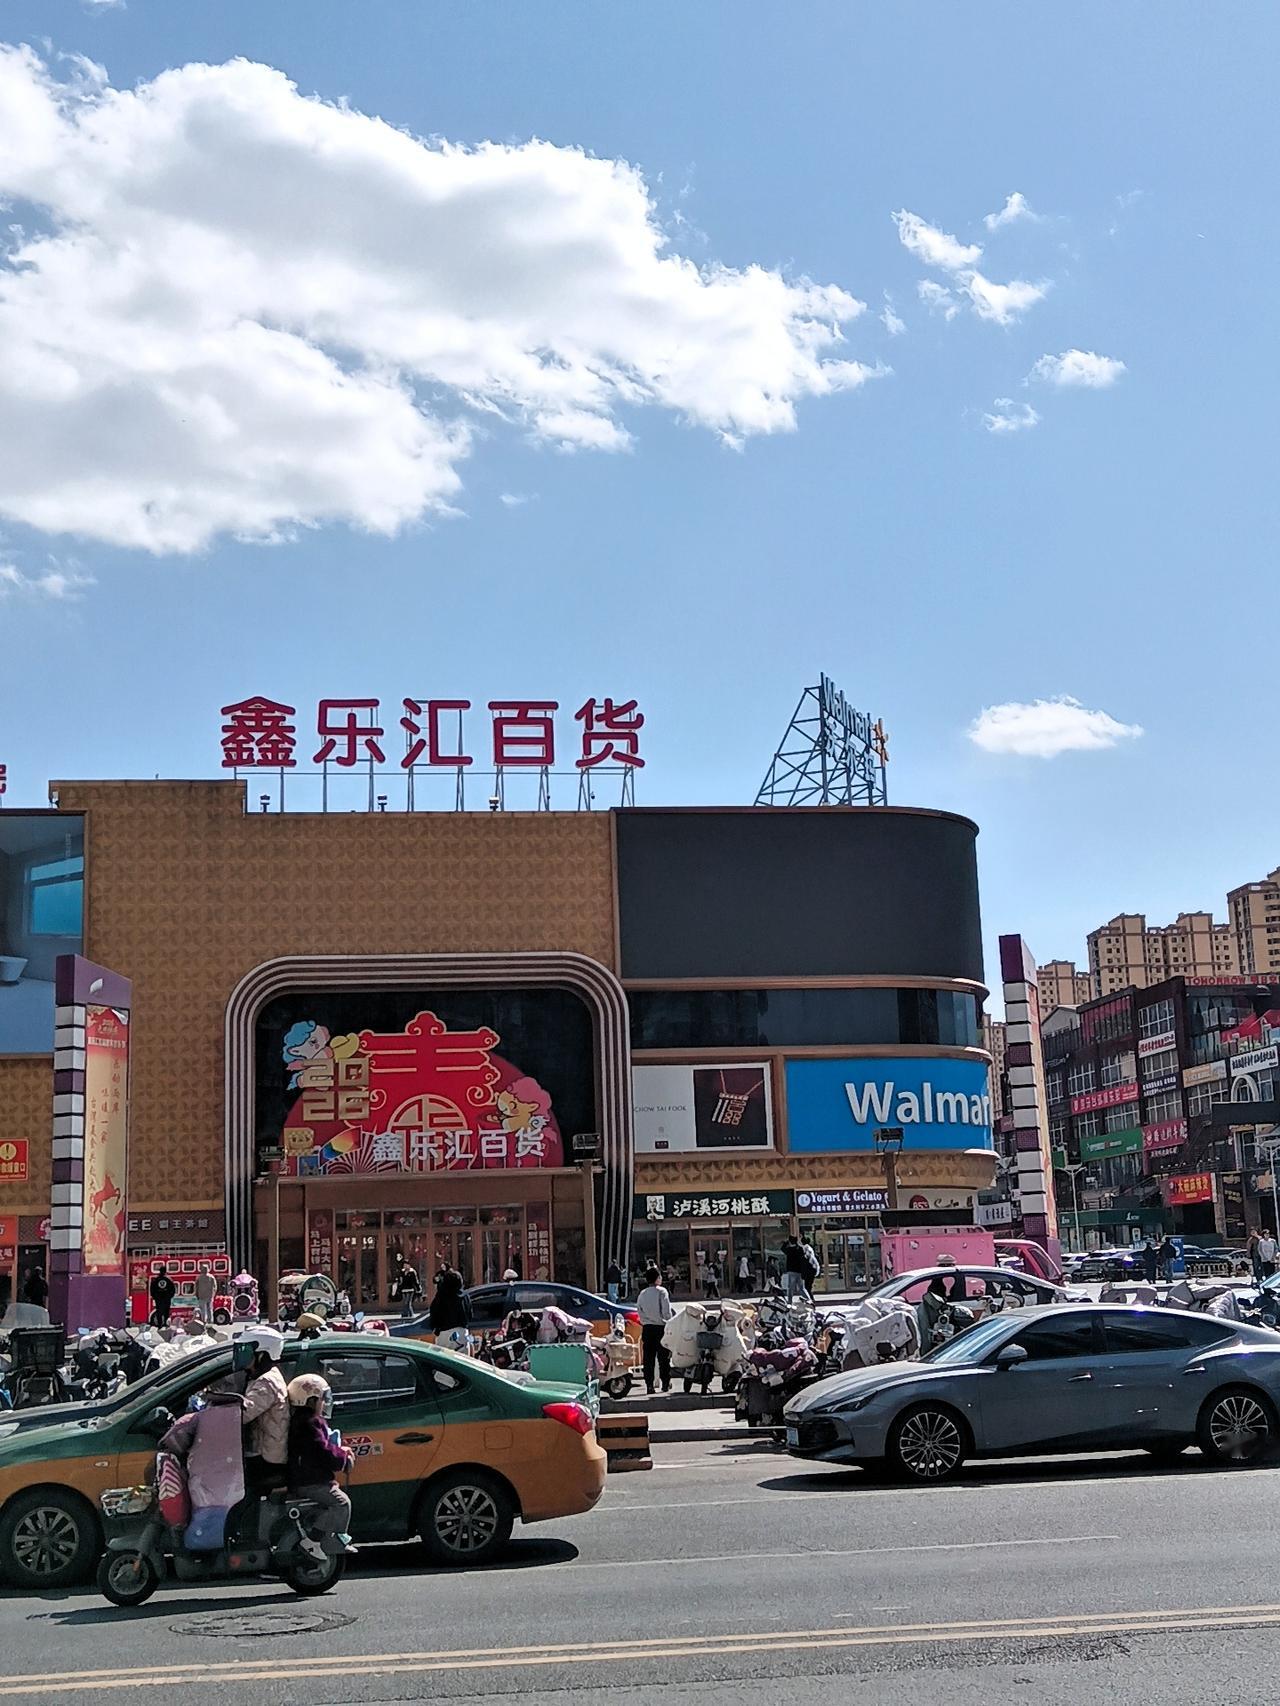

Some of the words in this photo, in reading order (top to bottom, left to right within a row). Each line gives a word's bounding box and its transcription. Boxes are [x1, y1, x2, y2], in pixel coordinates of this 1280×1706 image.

[220, 696, 646, 769] 鑫乐汇百货
[372, 1127, 545, 1161] 鑫乐汇百货
[673, 1196, 771, 1217] 泸溪河桃酥
[810, 1191, 840, 1205] Yogurt
[842, 1191, 851, 1201] &
[853, 1190, 882, 1201] Gelato
